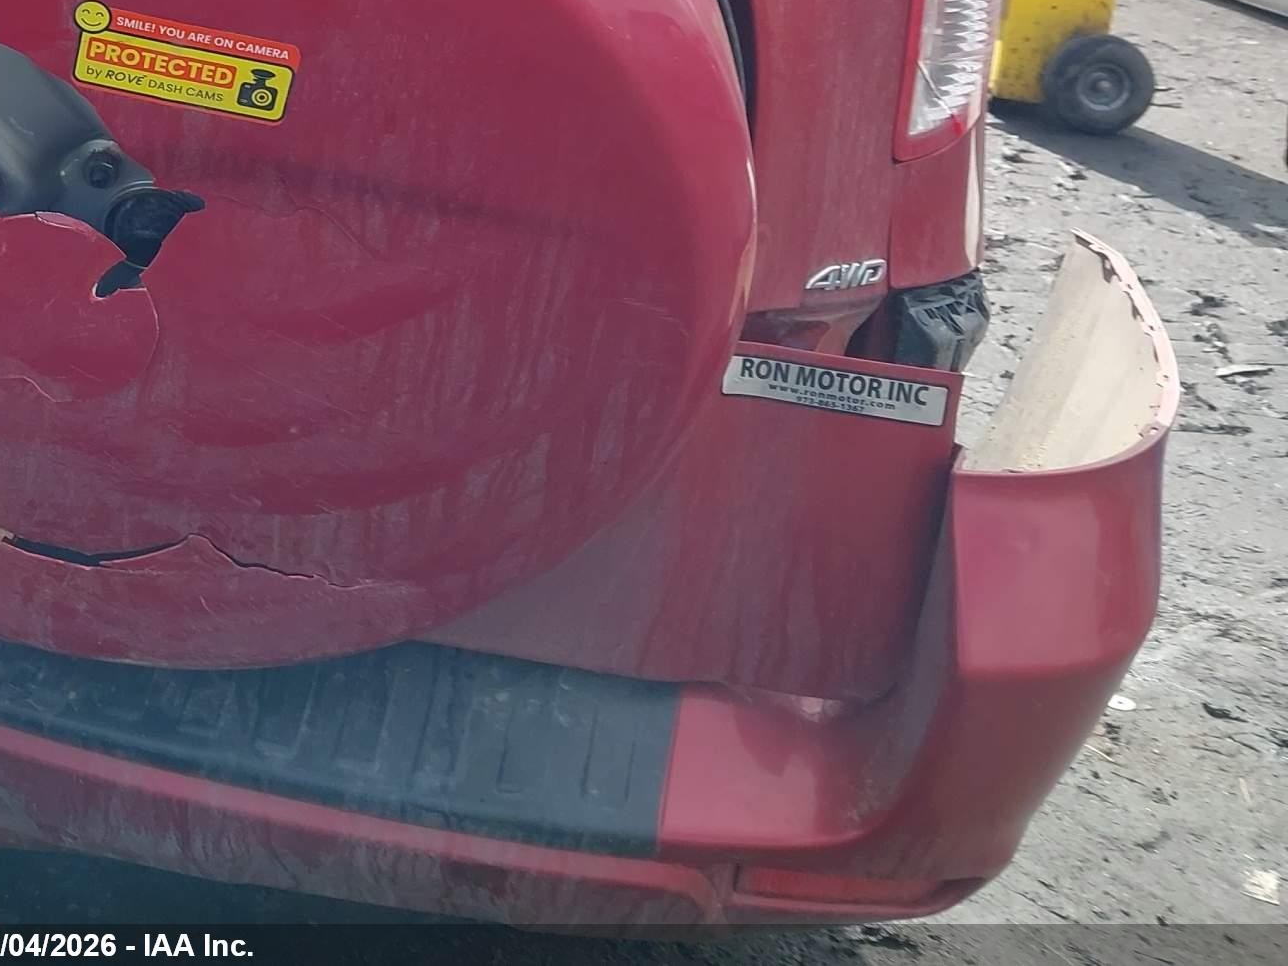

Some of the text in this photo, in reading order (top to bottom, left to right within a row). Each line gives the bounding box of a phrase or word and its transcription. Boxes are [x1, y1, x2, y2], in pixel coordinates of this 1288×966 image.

[116, 16, 289, 60] SMILE! YOU ARE ON CAMERA
[89, 41, 233, 85] PROTECTED
[86, 65, 103, 78] by
[148, 79, 183, 94] DASH
[186, 87, 223, 102] CAMS
[804, 258, 888, 291] 4WD
[740, 358, 930, 406] RON MOTOR INC
[767, 384, 896, 411] www.ronmotor.com
